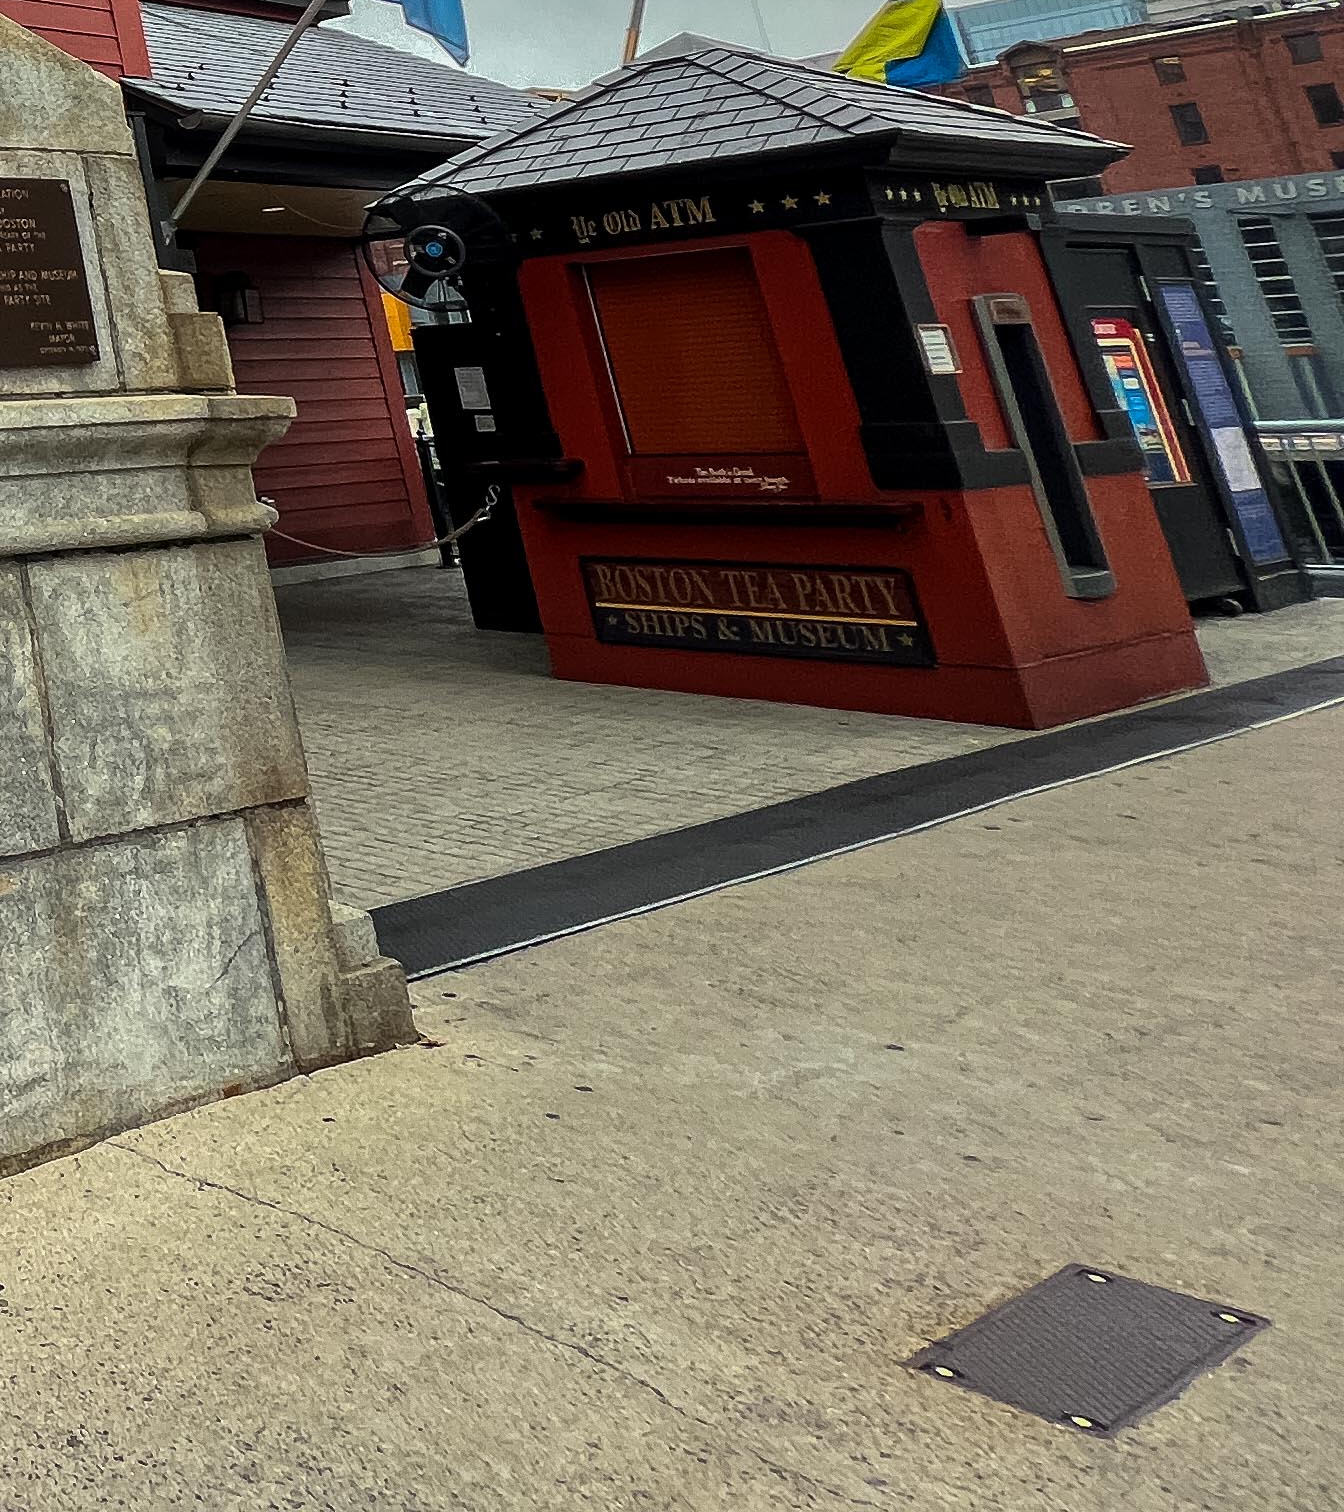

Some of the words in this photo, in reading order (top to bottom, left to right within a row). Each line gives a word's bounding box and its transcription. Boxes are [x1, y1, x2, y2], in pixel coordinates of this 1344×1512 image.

[650, 195, 717, 230] ATM
[5, 242, 36, 253] PARTY
[18, 270, 38, 281] AND
[40, 269, 79, 281] MUSEUM
[593, 564, 717, 605] BOSTON
[720, 570, 788, 610] TEA
[791, 572, 901, 617] PARTY
[624, 611, 707, 640] SHIPS
[717, 617, 742, 641] &
[748, 620, 895, 653] MUSEUM
